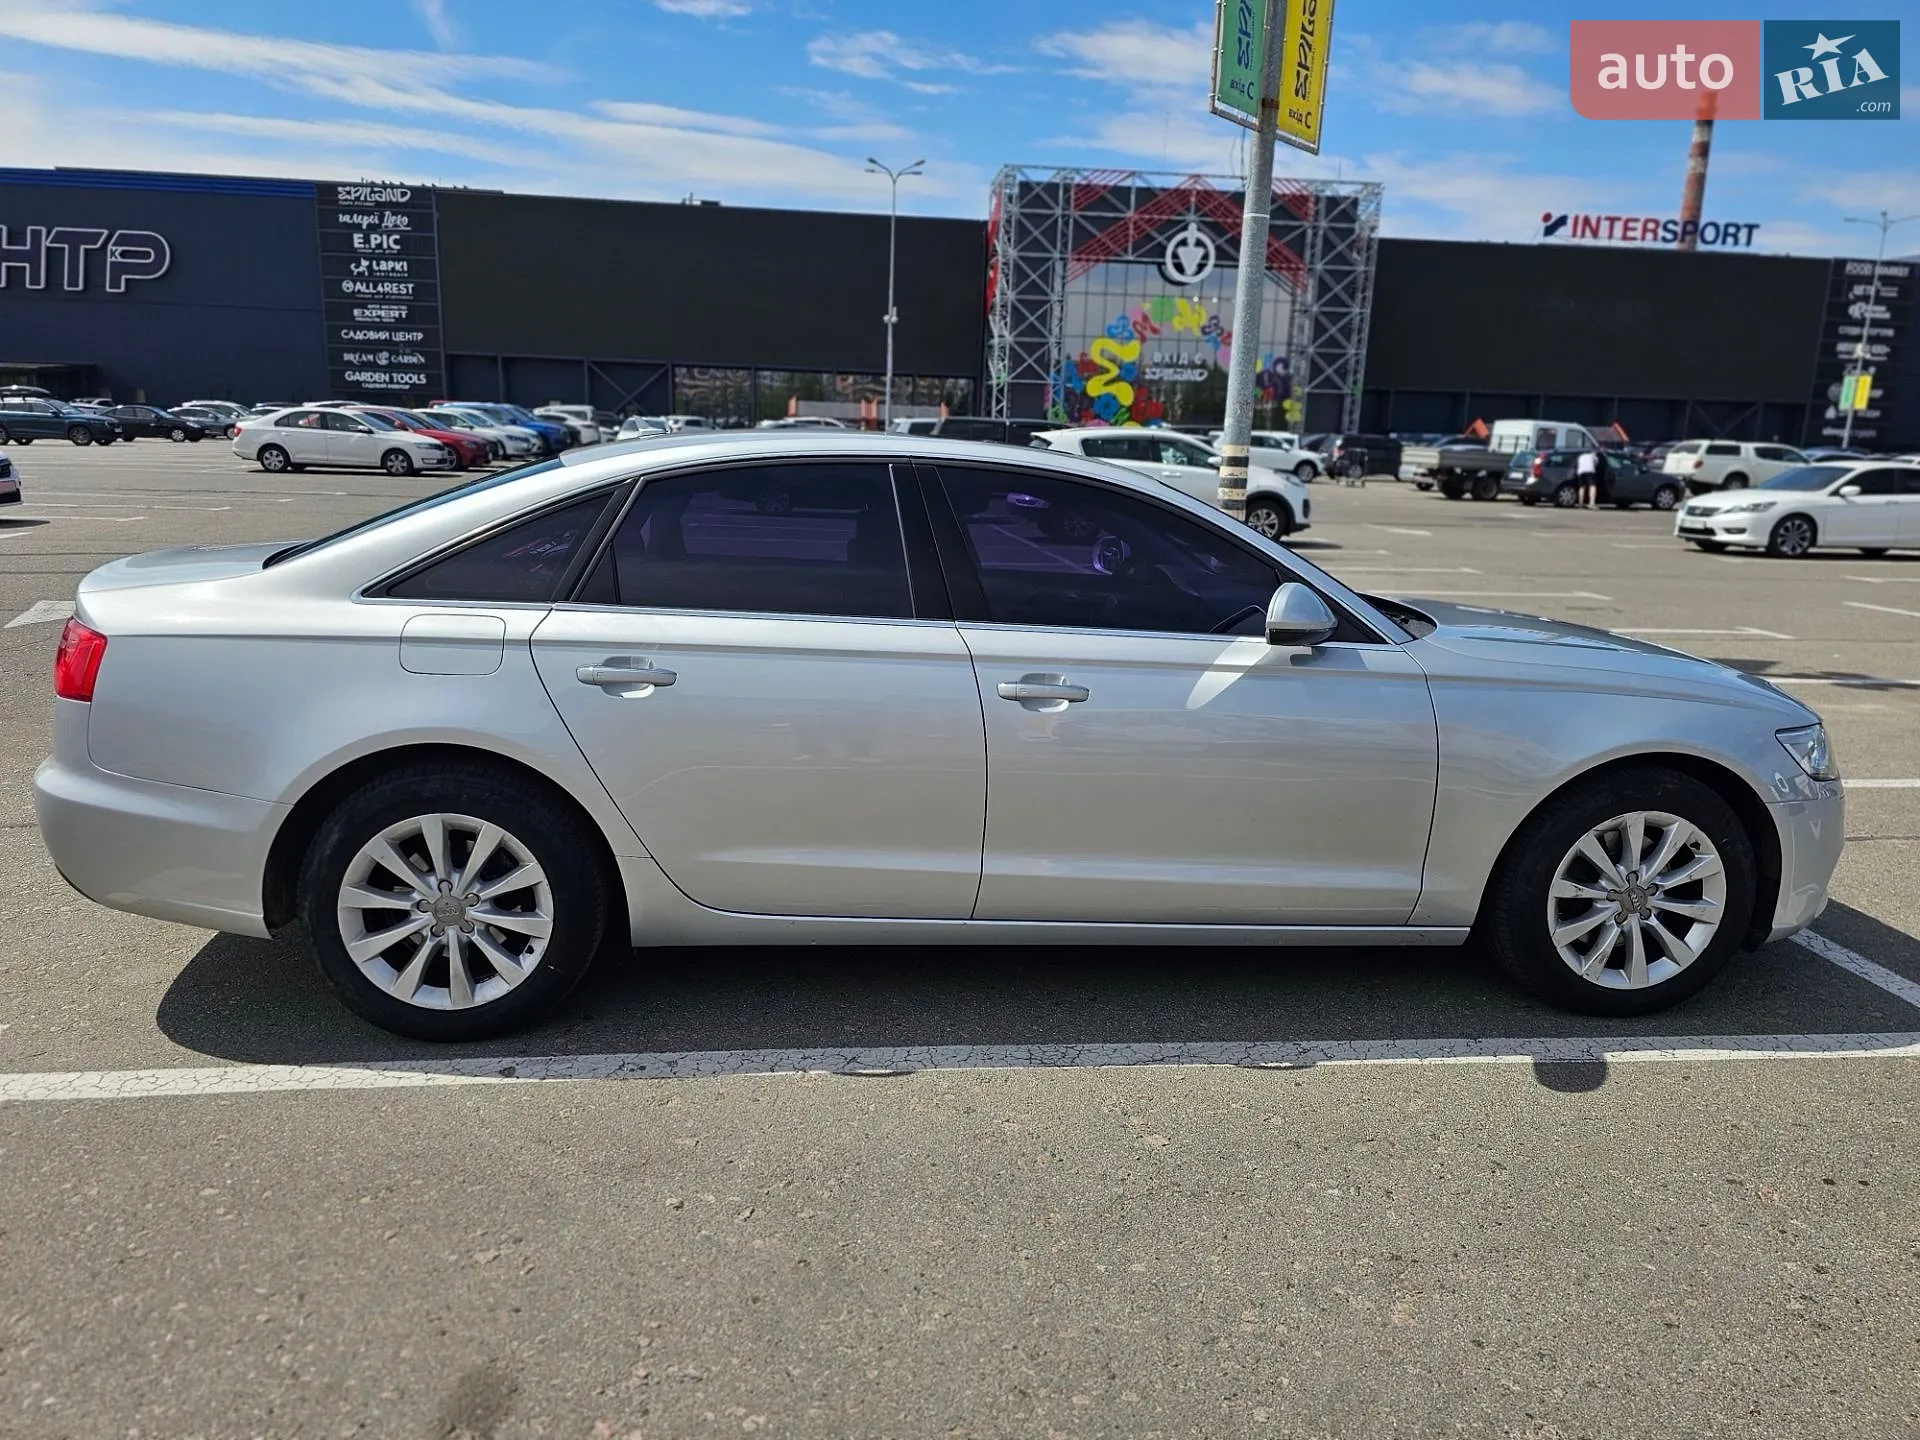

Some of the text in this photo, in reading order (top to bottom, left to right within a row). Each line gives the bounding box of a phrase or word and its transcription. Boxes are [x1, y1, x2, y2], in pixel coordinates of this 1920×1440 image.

[1571, 214, 1760, 248] INTERSPORT
[352, 233, 402, 250] E.PIC
[354, 281, 415, 295] ALL4REST
[340, 329, 424, 342] САДОВИЙ ЦЕНТР
[344, 370, 428, 385] GARDEN TOOLS
